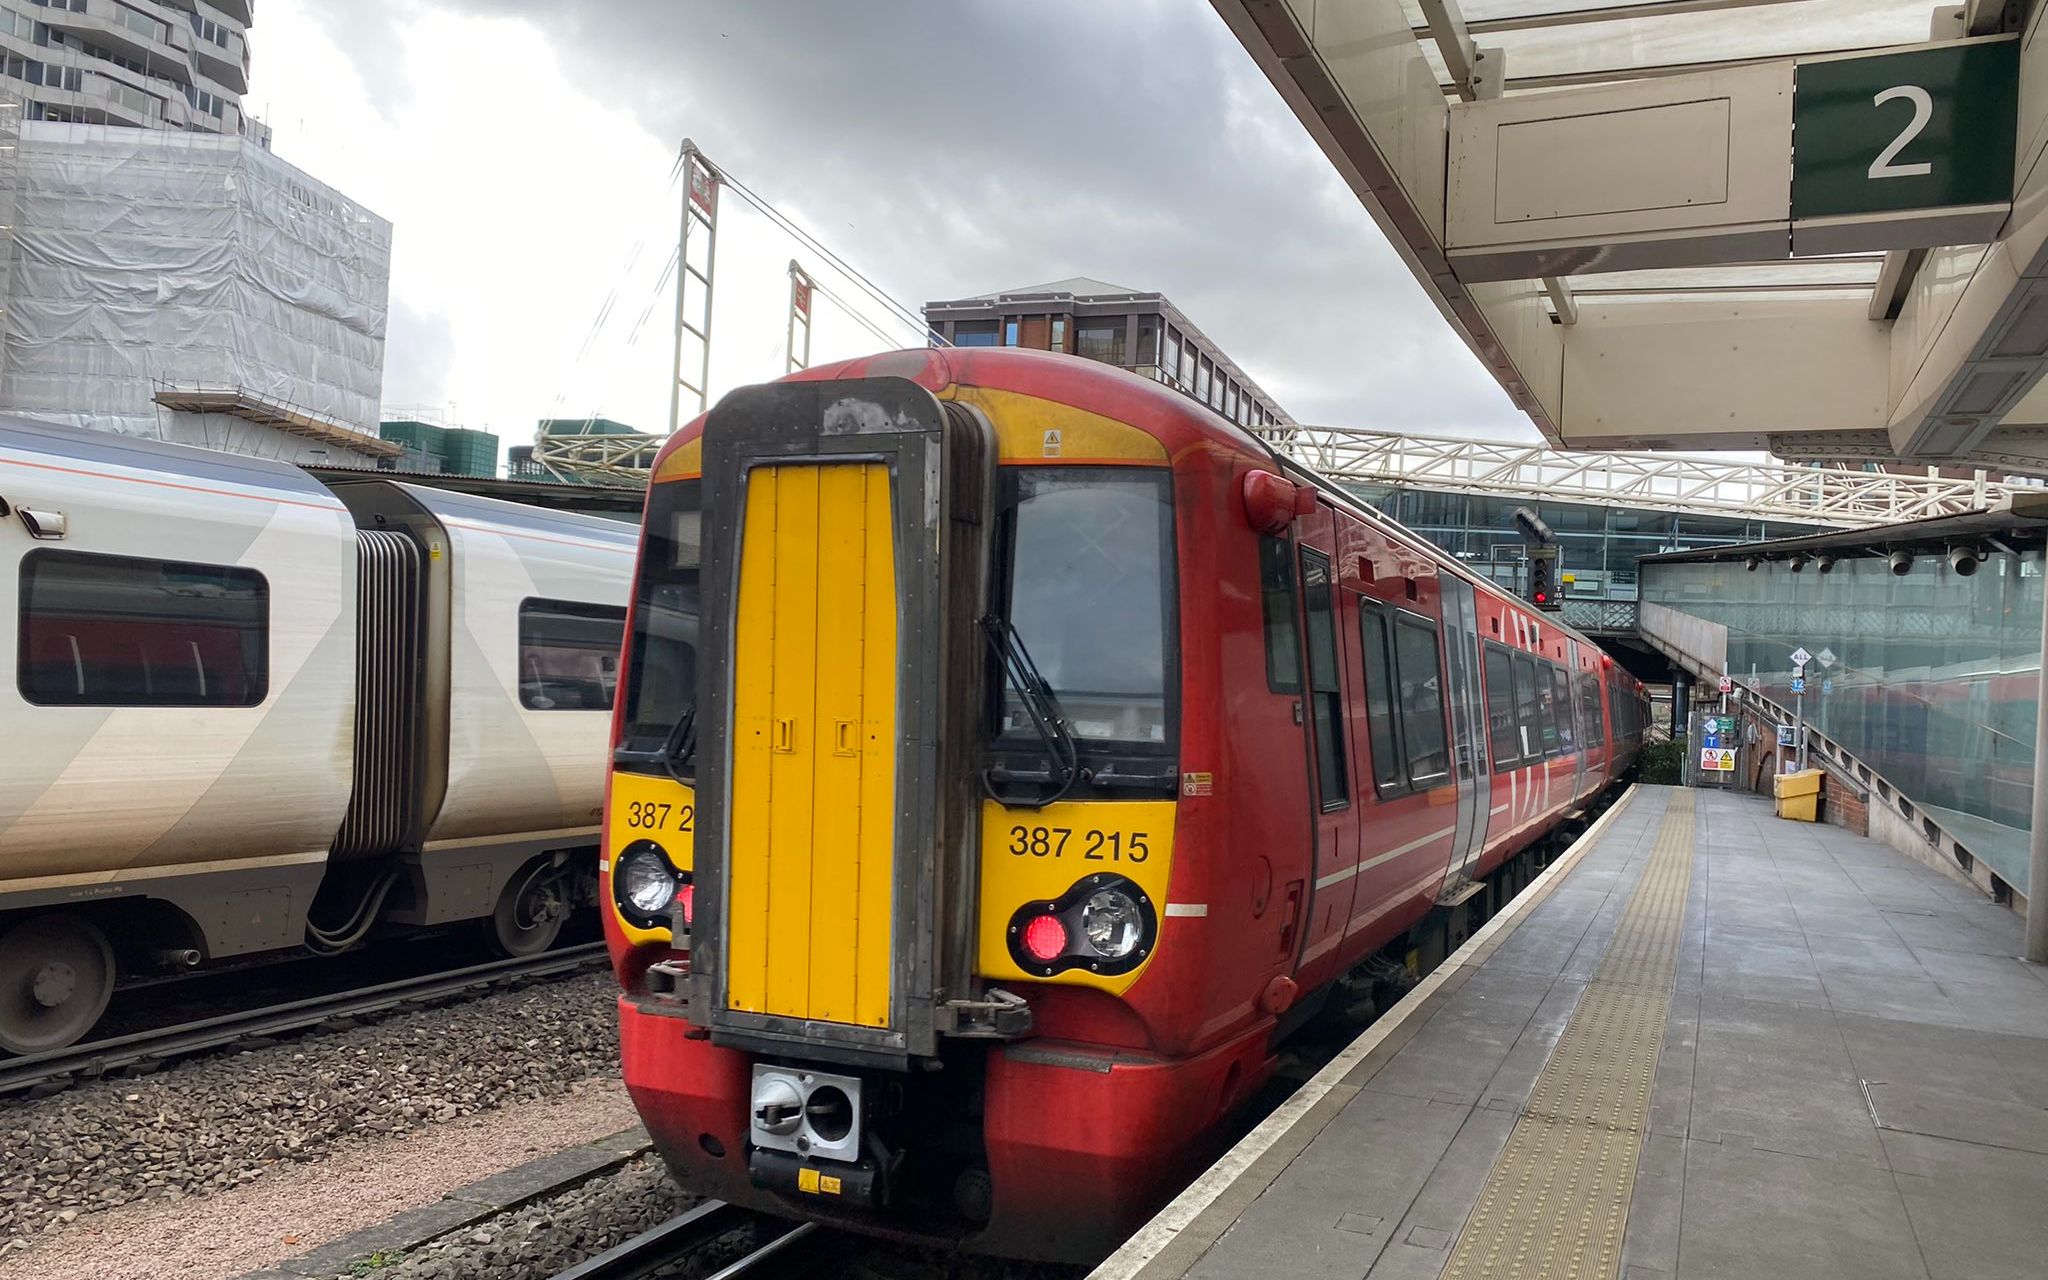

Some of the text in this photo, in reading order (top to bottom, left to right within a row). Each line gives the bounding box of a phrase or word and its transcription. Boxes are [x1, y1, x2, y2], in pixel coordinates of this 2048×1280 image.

[1868, 85, 1933, 179] 2
[1707, 736, 1716, 747] T
[628, 801, 672, 829] 387
[1009, 825, 1149, 863] 387 215
